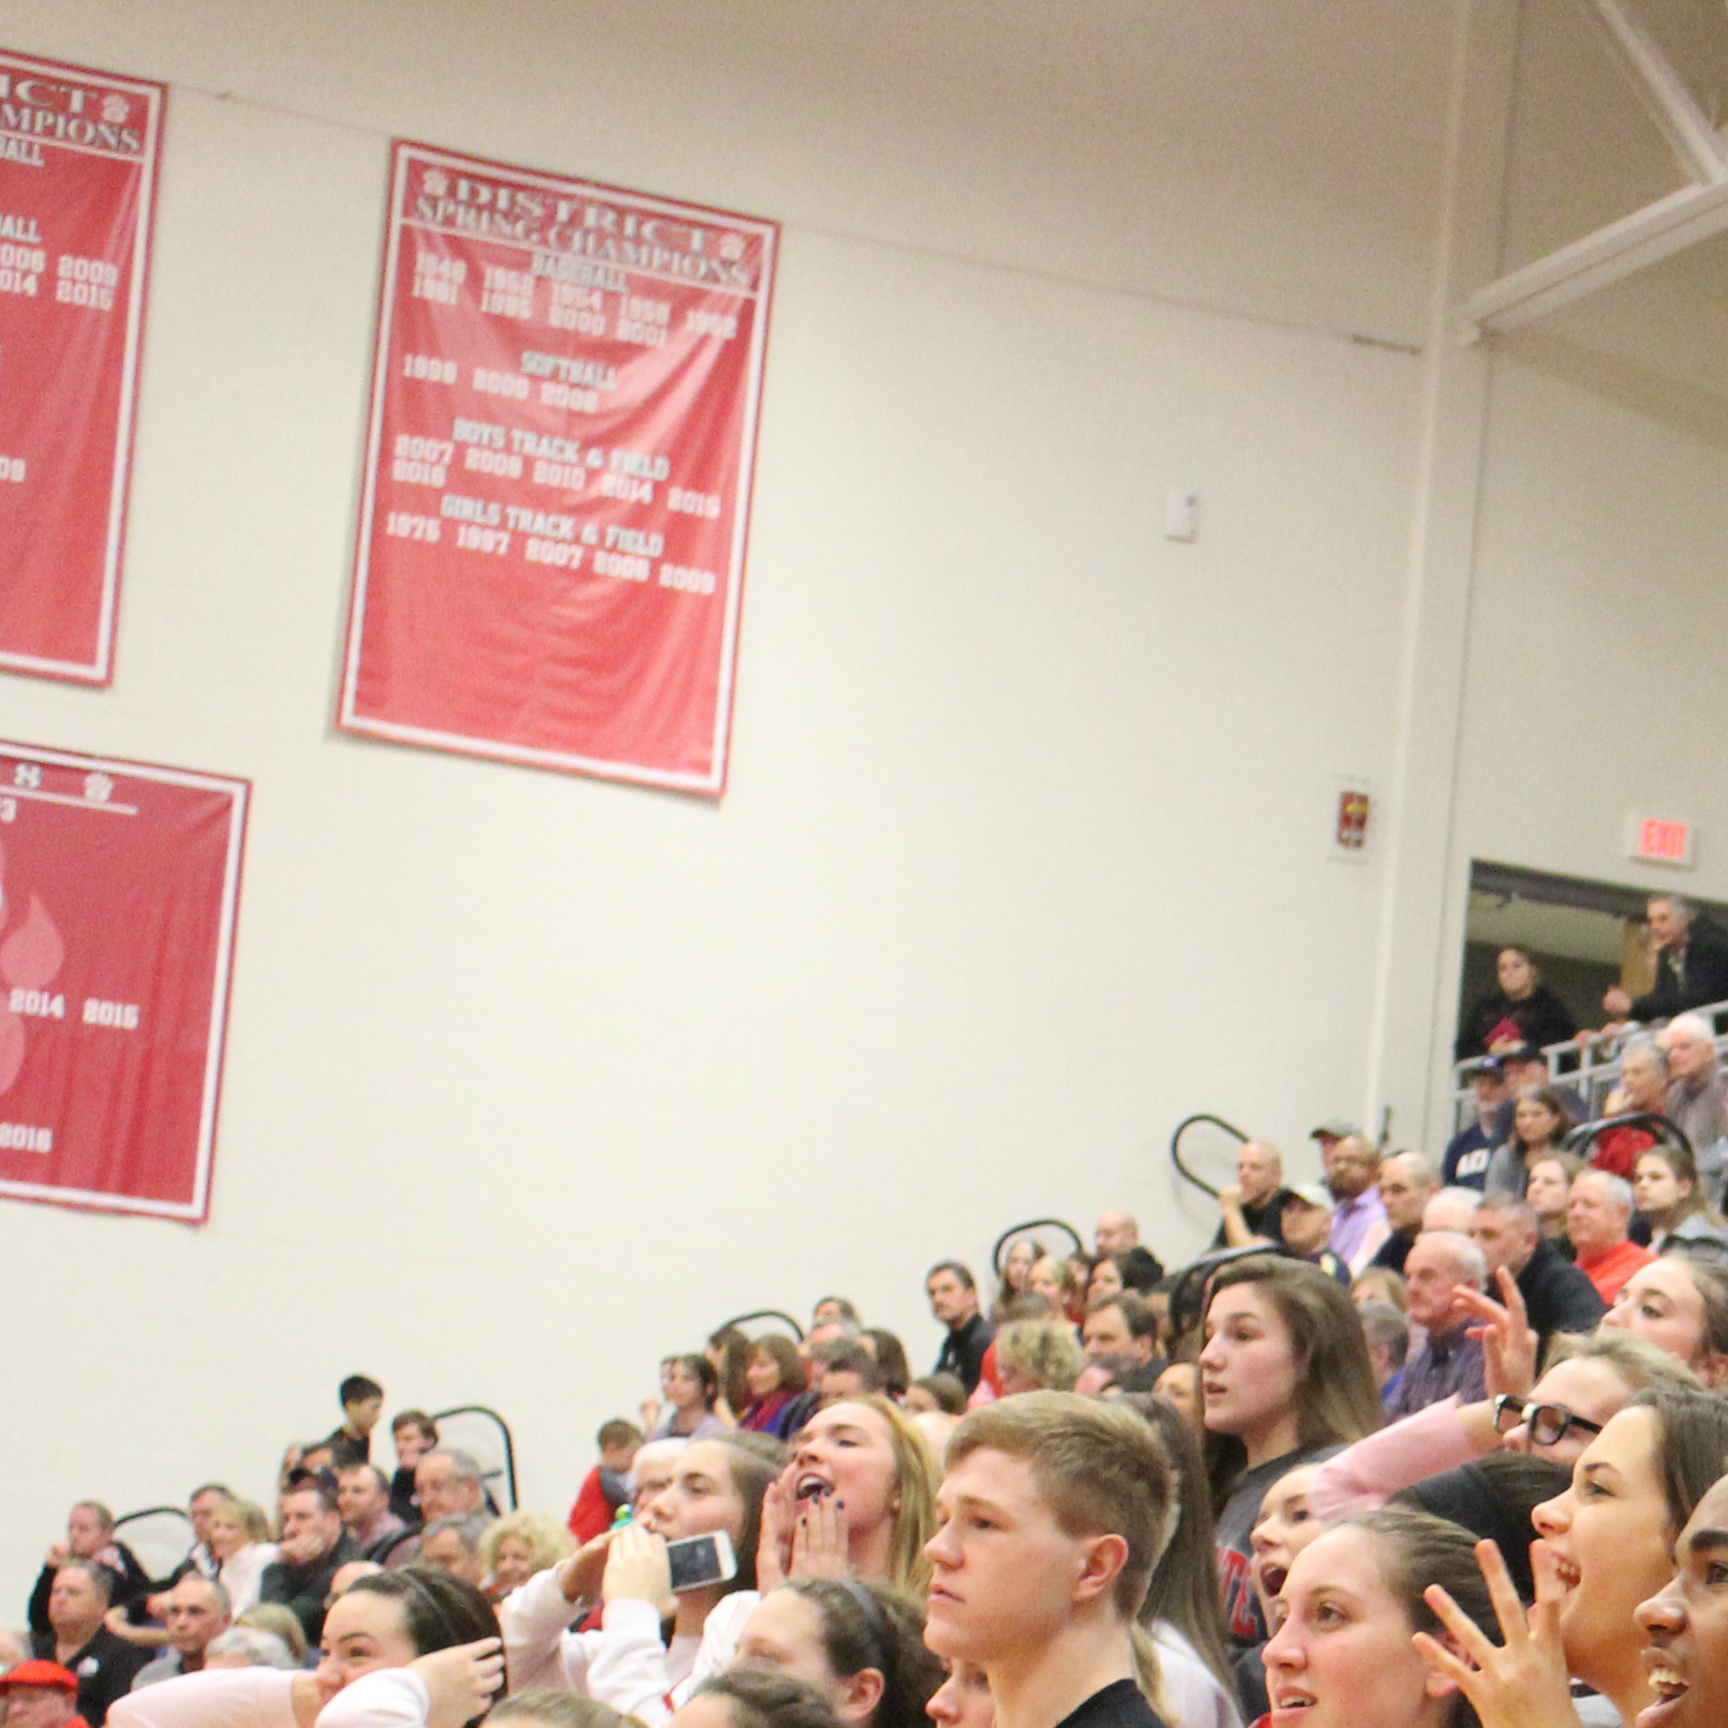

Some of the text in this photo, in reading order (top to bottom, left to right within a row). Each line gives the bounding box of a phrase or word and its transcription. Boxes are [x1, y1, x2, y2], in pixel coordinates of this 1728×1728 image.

[416, 195, 749, 285] SPRING CHAMPIONS
[456, 178, 716, 252] DISTRICT
[521, 350, 620, 392] SOFTBALL
[453, 416, 507, 448] BOYS
[510, 428, 581, 464] TRACK
[609, 449, 671, 481] FIELD
[441, 493, 501, 526] GIRLS
[505, 505, 577, 541] TRACK
[605, 524, 665, 558] FIELD
[1640, 817, 1687, 859] EXIT
